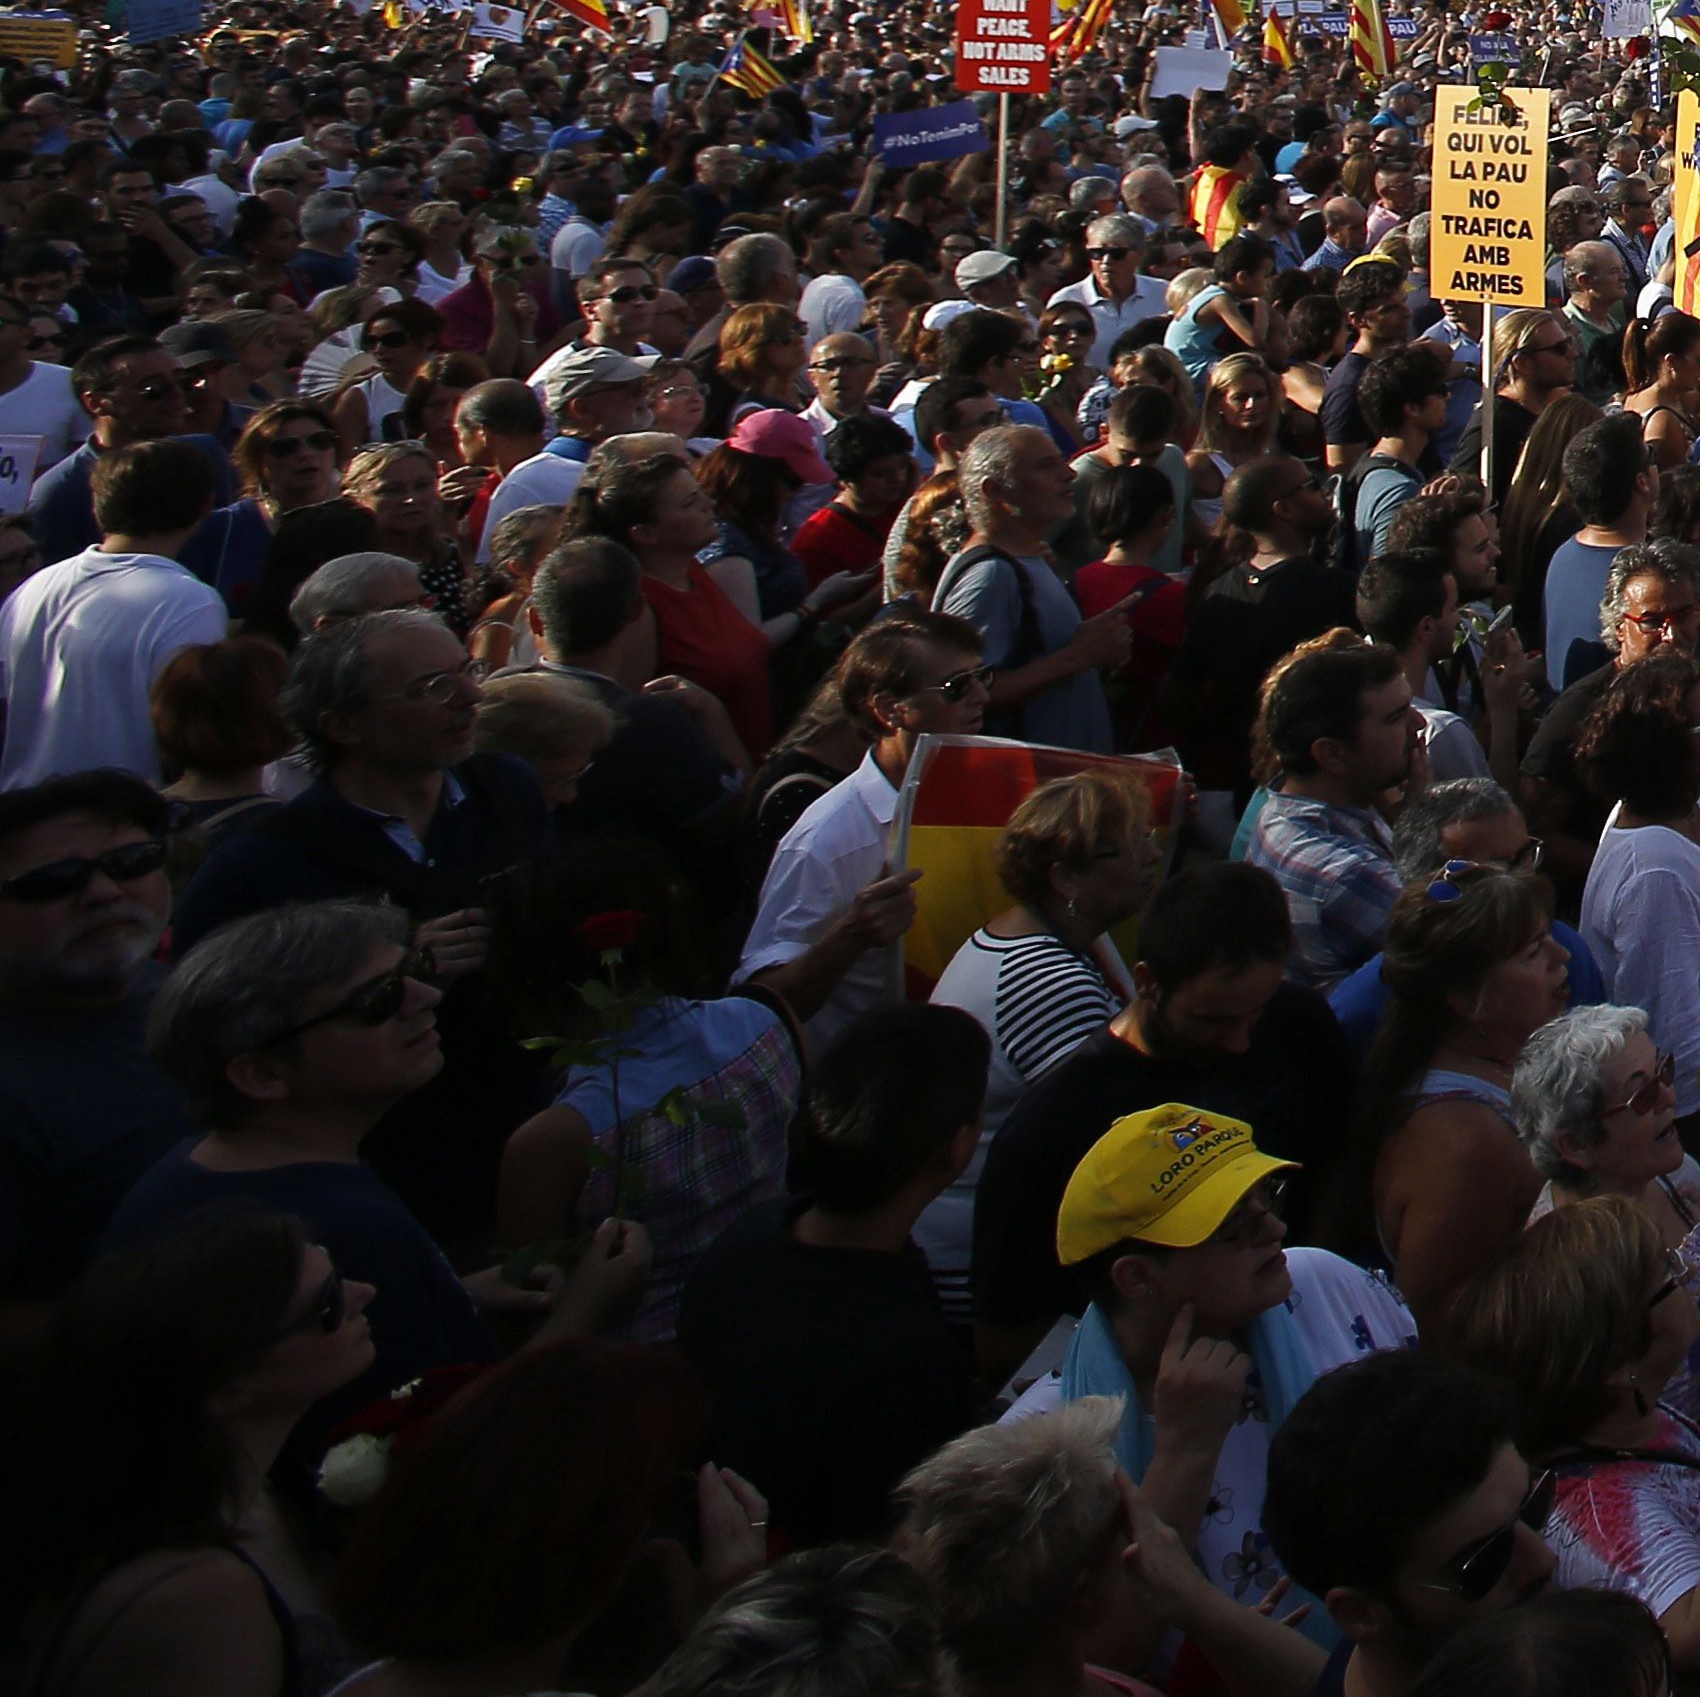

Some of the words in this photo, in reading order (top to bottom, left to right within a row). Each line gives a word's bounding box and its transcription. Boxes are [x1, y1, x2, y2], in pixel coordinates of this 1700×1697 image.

[976, 17, 1032, 39] PEACE,
[962, 41, 997, 60] NOT
[996, 42, 1046, 62] ARMS
[978, 66, 1030, 86] SALES
[1447, 131, 1484, 153] QUI
[1489, 134, 1533, 155] VOL
[1450, 160, 1477, 180] LA
[1482, 162, 1528, 183] PAU
[1469, 189, 1501, 209] NO
[1441, 214, 1534, 240] TRAFICA
[1463, 244, 1511, 266] AMB
[1450, 270, 1524, 295] ARMES
[1150, 1153, 1195, 1193] LORO
[1194, 1126, 1244, 1156] PARQUE
